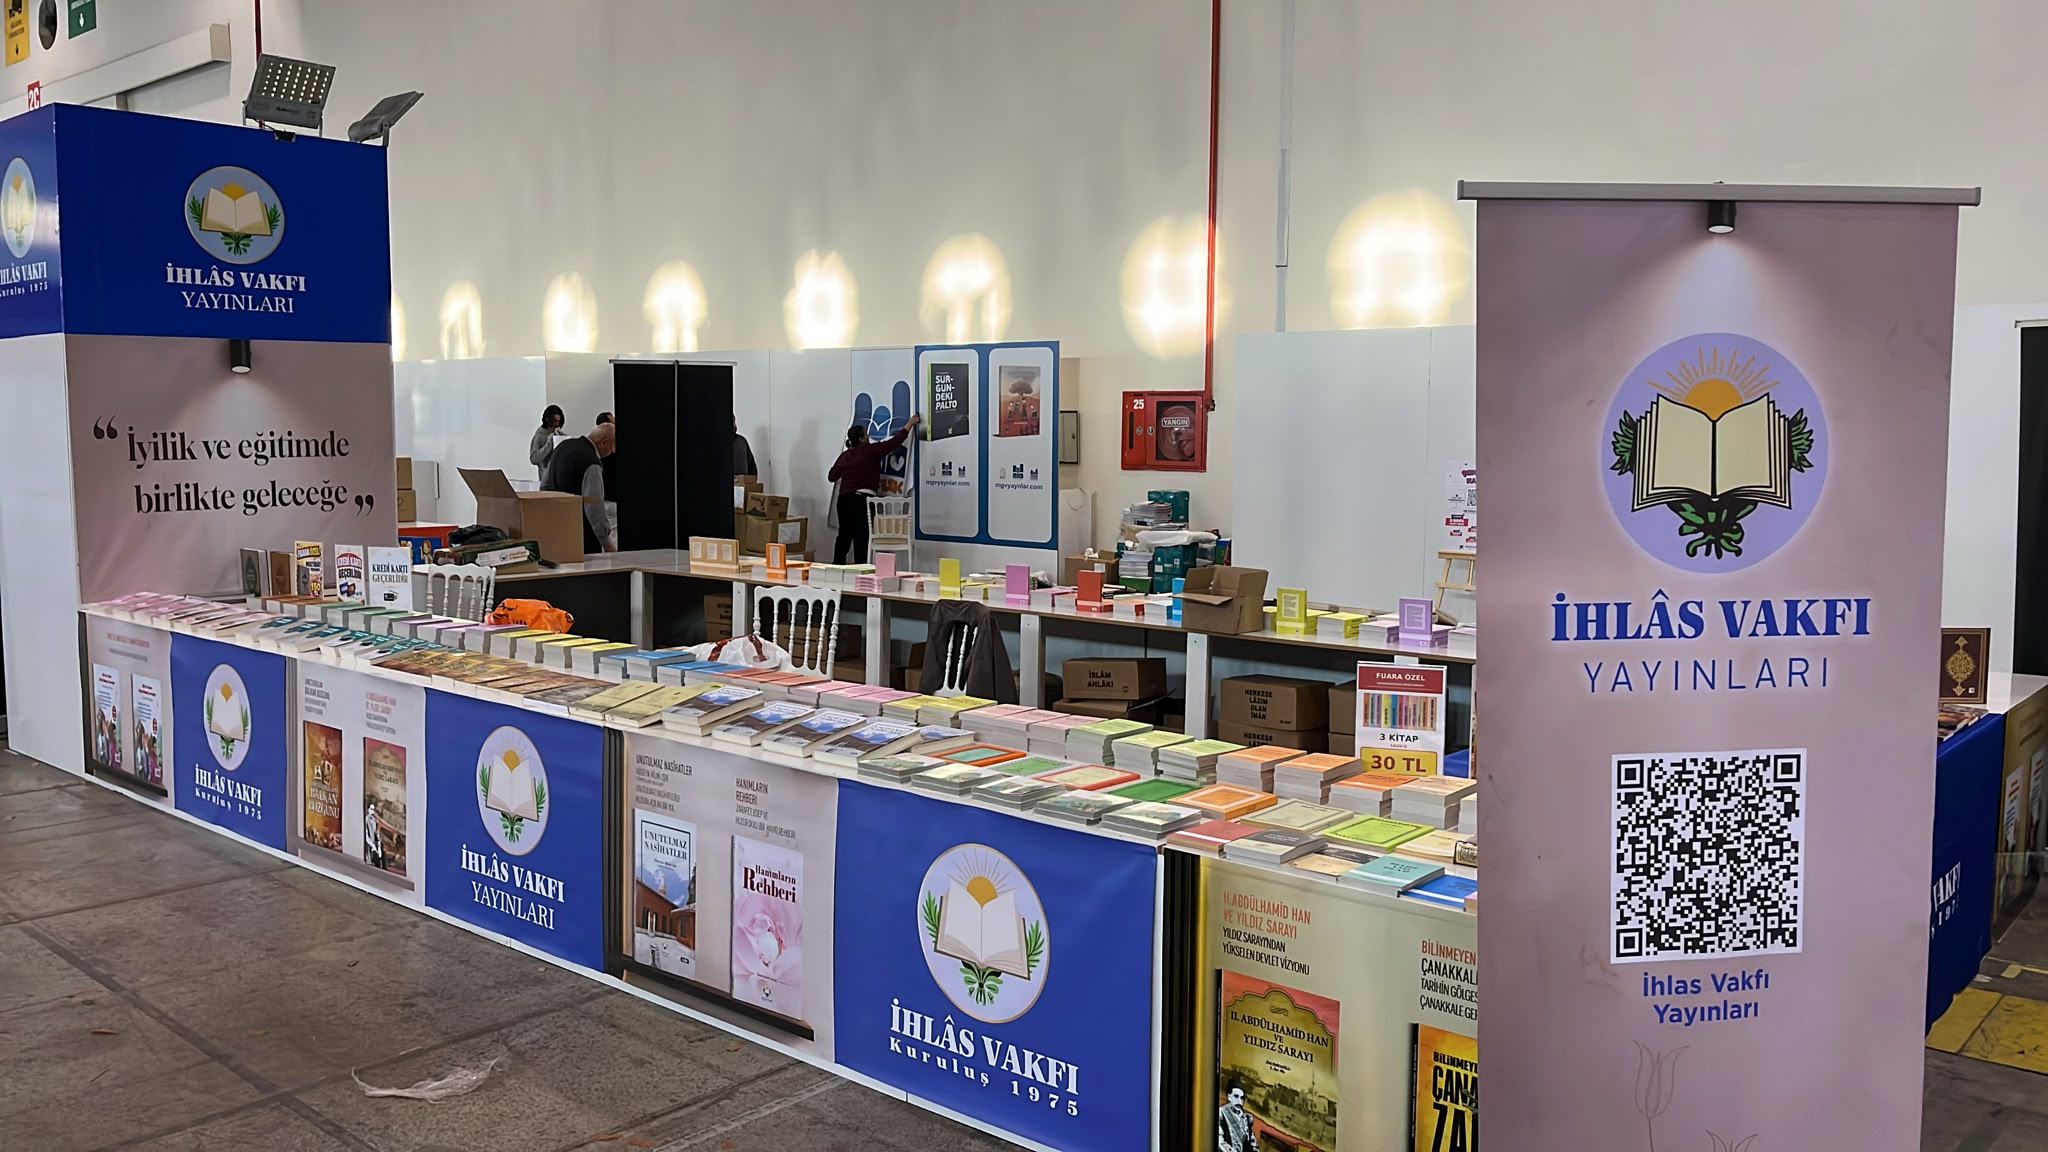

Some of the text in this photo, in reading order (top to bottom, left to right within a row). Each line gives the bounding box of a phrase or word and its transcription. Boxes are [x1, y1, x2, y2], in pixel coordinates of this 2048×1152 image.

[0, 261, 47, 285] HLÂS VAKFI
[166, 262, 306, 292] İHLÂS VAKFI
[181, 290, 295, 313] YAYINLARI
[935, 399, 958, 411] PALTO
[1133, 399, 1145, 410] 25
[127, 425, 197, 469] İyilik
[201, 439, 232, 460] ve
[238, 430, 350, 467] eğitimde
[134, 482, 235, 514] birlikte
[242, 480, 348, 516] geleceğe
[372, 562, 408, 573] KREDİ KARTI
[372, 574, 408, 584] GEÇERLİDİR
[1551, 588, 1871, 641] İHLÂS VAKFI
[1376, 672, 1403, 680] FUARA
[1583, 657, 1828, 693] YAYINLARI
[1244, 689, 1273, 698] HERKESE
[1379, 733, 1419, 743] 3 KİTAP
[636, 754, 693, 776] UNUTULMAZ NASİHATLER
[1371, 755, 1427, 773] 30 TL
[194, 763, 262, 808] İHLÂS VAKFI
[735, 777, 769, 794] HANIMLARIN
[238, 803, 262, 821] 1975
[644, 830, 688, 850] UNUTULMAZ
[644, 840, 688, 861] NASİHATLER
[460, 843, 565, 903] İHLÂS VAKFI
[743, 866, 796, 904] Rehberi
[755, 864, 797, 886] Hanımların
[471, 880, 555, 930] YAYINLARI
[1291, 907, 1311, 925] HAN
[1222, 926, 1243, 942] YILDIZ
[1223, 909, 1297, 940] VE YILDIZ SARAYI
[1222, 941, 1310, 976] YÜKSELEN DEVLET VİZYONU
[1421, 938, 1477, 966] BİLİNMEYEN
[1420, 977, 1450, 996] TARİHİN
[1711, 968, 1769, 993] Vakfı
[1419, 994, 1464, 1018] ÇANAKKALE
[1653, 999, 1758, 1027] Yayınları
[1240, 1013, 1306, 1041] ABDÜLHAMİD
[1306, 1032, 1329, 1048] HAN
[1273, 1034, 1284, 1044] VE
[890, 998, 1079, 1096] İHLÂS VAKFI
[1243, 1033, 1314, 1064] YILDIZ SARAYI
[889, 1036, 1078, 1117] Kuruluş 1975
